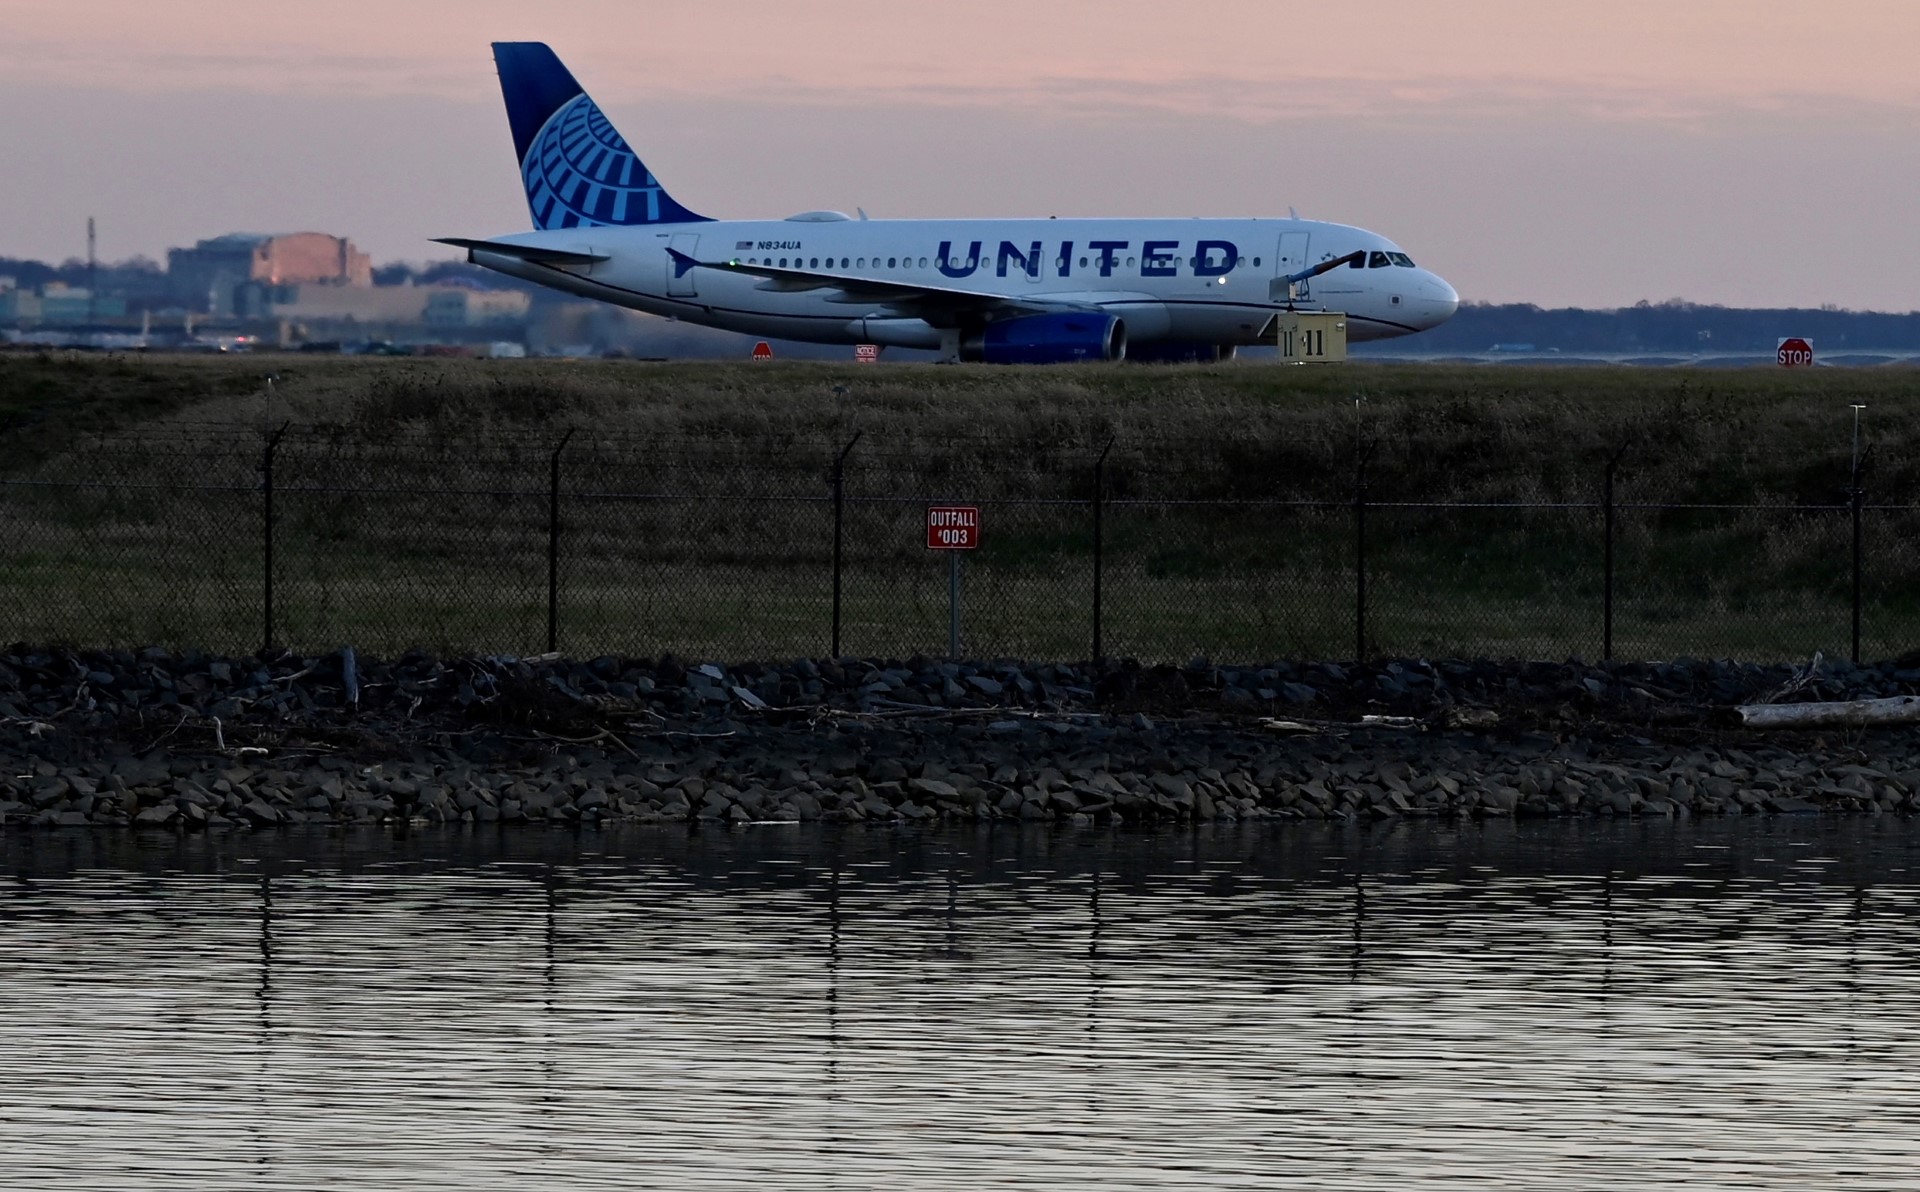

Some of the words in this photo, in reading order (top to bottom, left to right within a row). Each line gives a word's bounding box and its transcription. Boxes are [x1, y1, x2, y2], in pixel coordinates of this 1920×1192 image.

[757, 241, 801, 250] N834UA
[937, 240, 1238, 278] UNITED
[1779, 350, 1811, 365] STOP
[931, 511, 975, 526] OUTFALL
